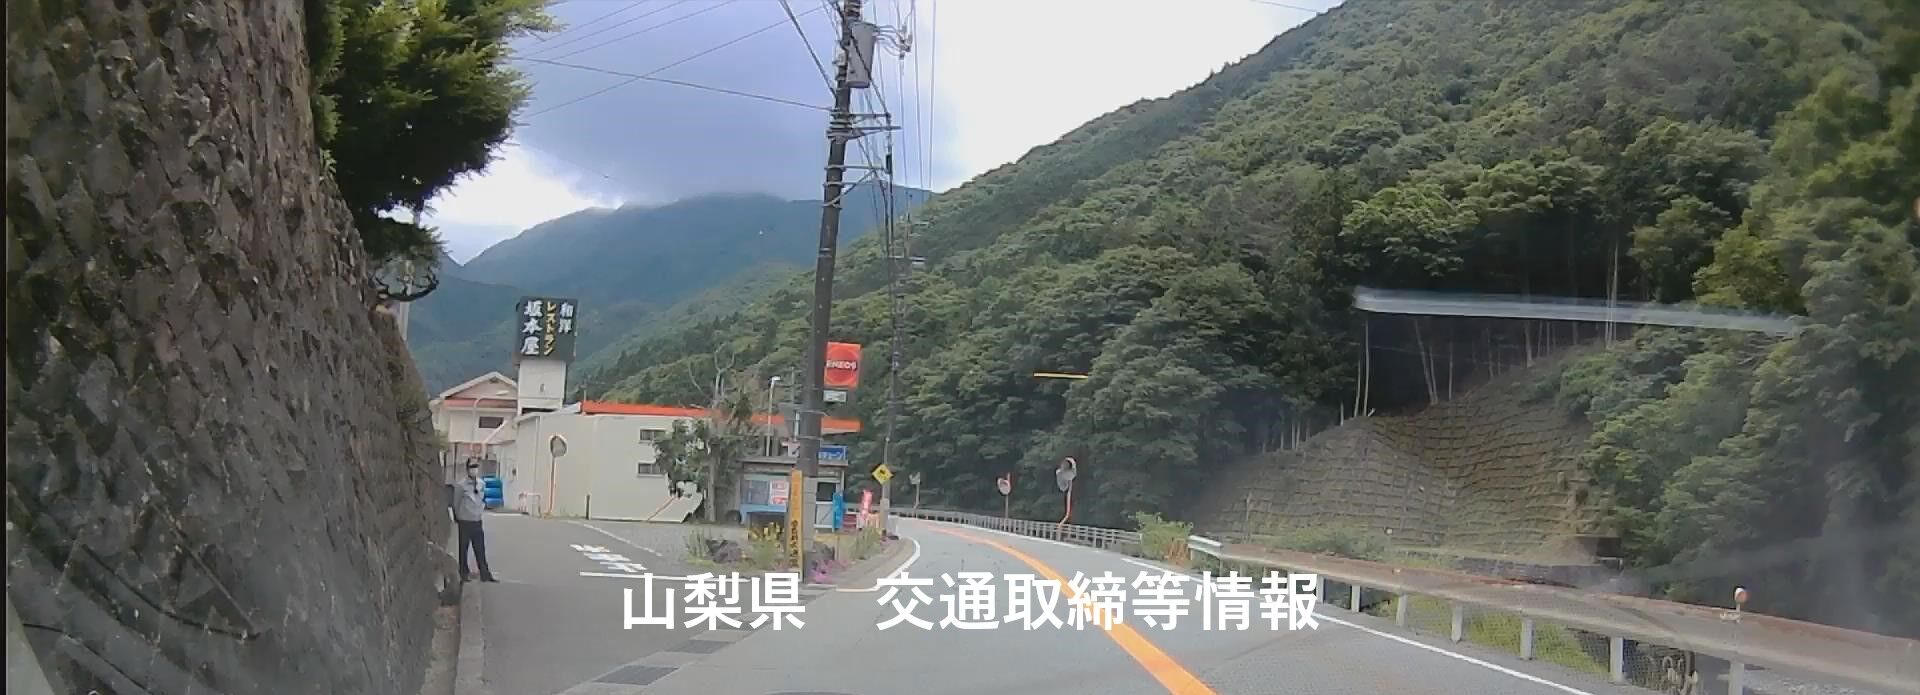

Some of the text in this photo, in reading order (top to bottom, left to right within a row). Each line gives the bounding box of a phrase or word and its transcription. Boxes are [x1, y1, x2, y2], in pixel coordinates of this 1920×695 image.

[521, 300, 543, 355] 坂本屋
[543, 301, 557, 355] レストラン
[826, 360, 857, 370] ENEOS
